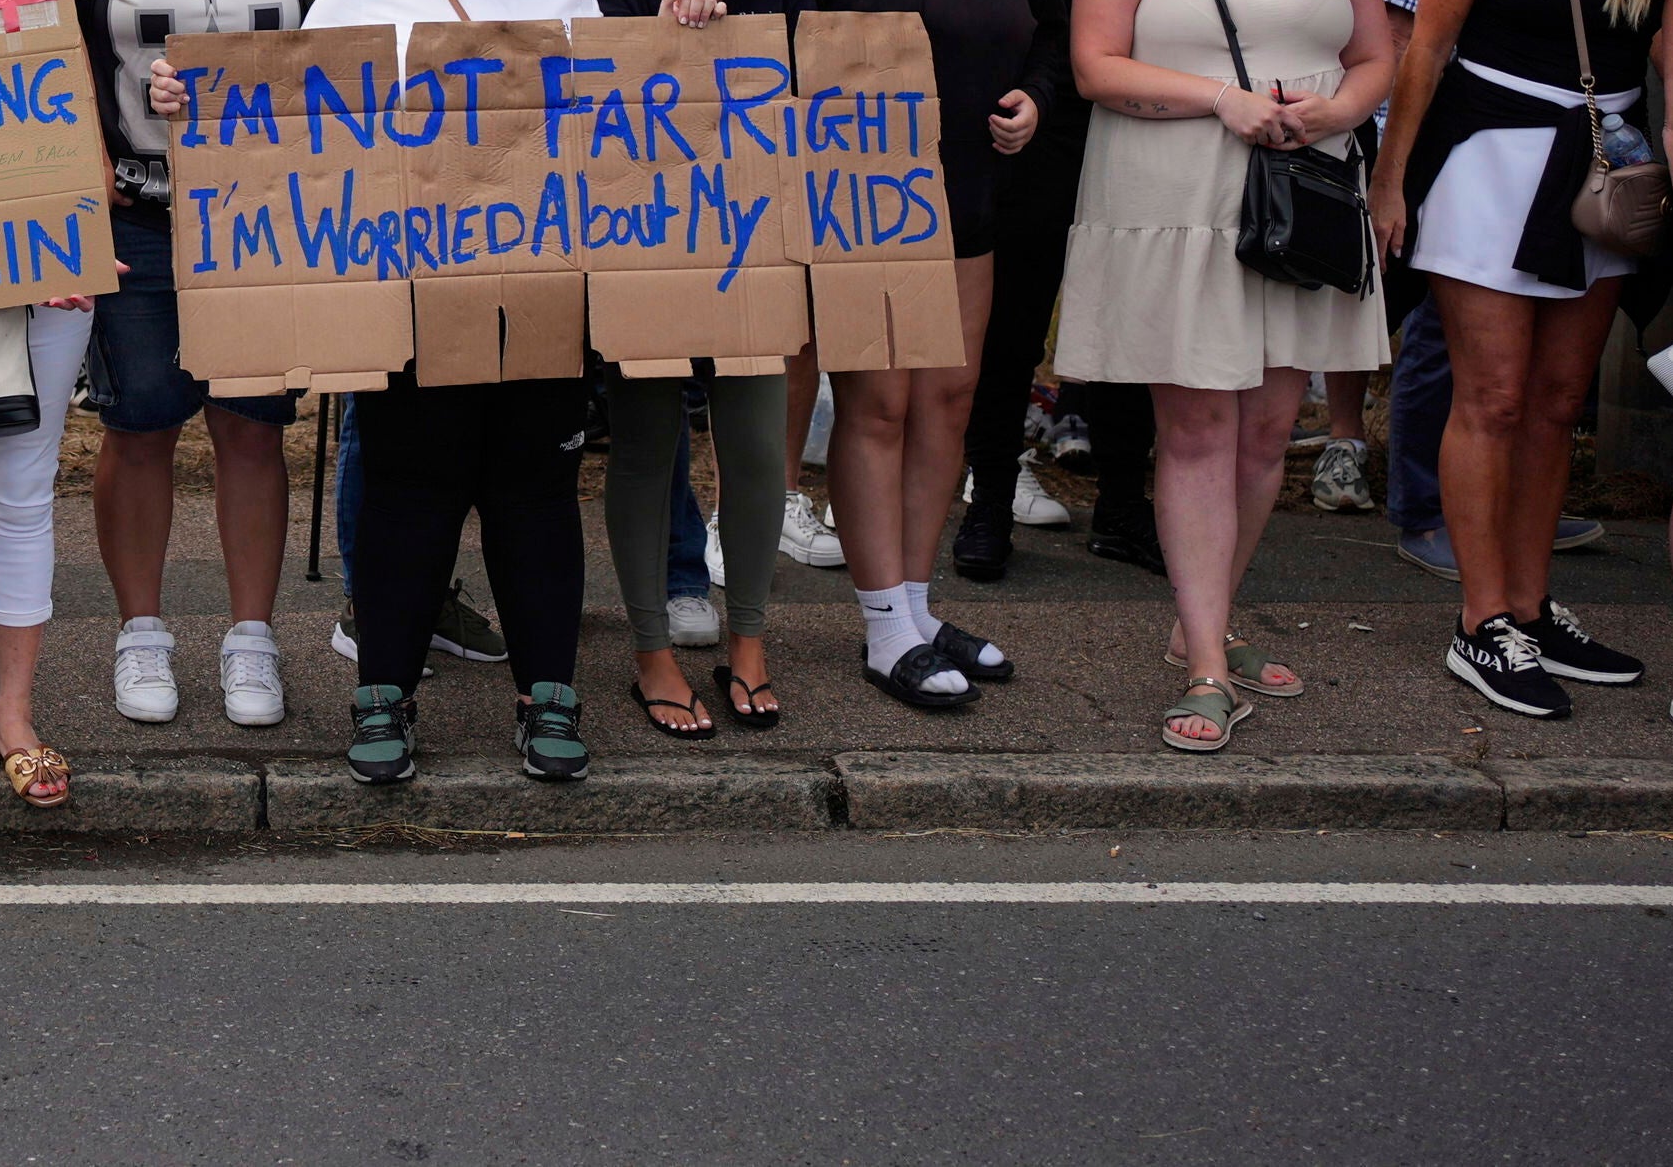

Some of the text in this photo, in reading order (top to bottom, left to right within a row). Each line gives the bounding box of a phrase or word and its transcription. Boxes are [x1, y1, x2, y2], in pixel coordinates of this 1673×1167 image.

[179, 55, 927, 161] I'M NOT FAR RIGHT
[188, 180, 284, 274] I'M
[287, 168, 526, 281] WORRIED
[805, 166, 939, 253] KIDS
[1453, 635, 1503, 672] PRADA
